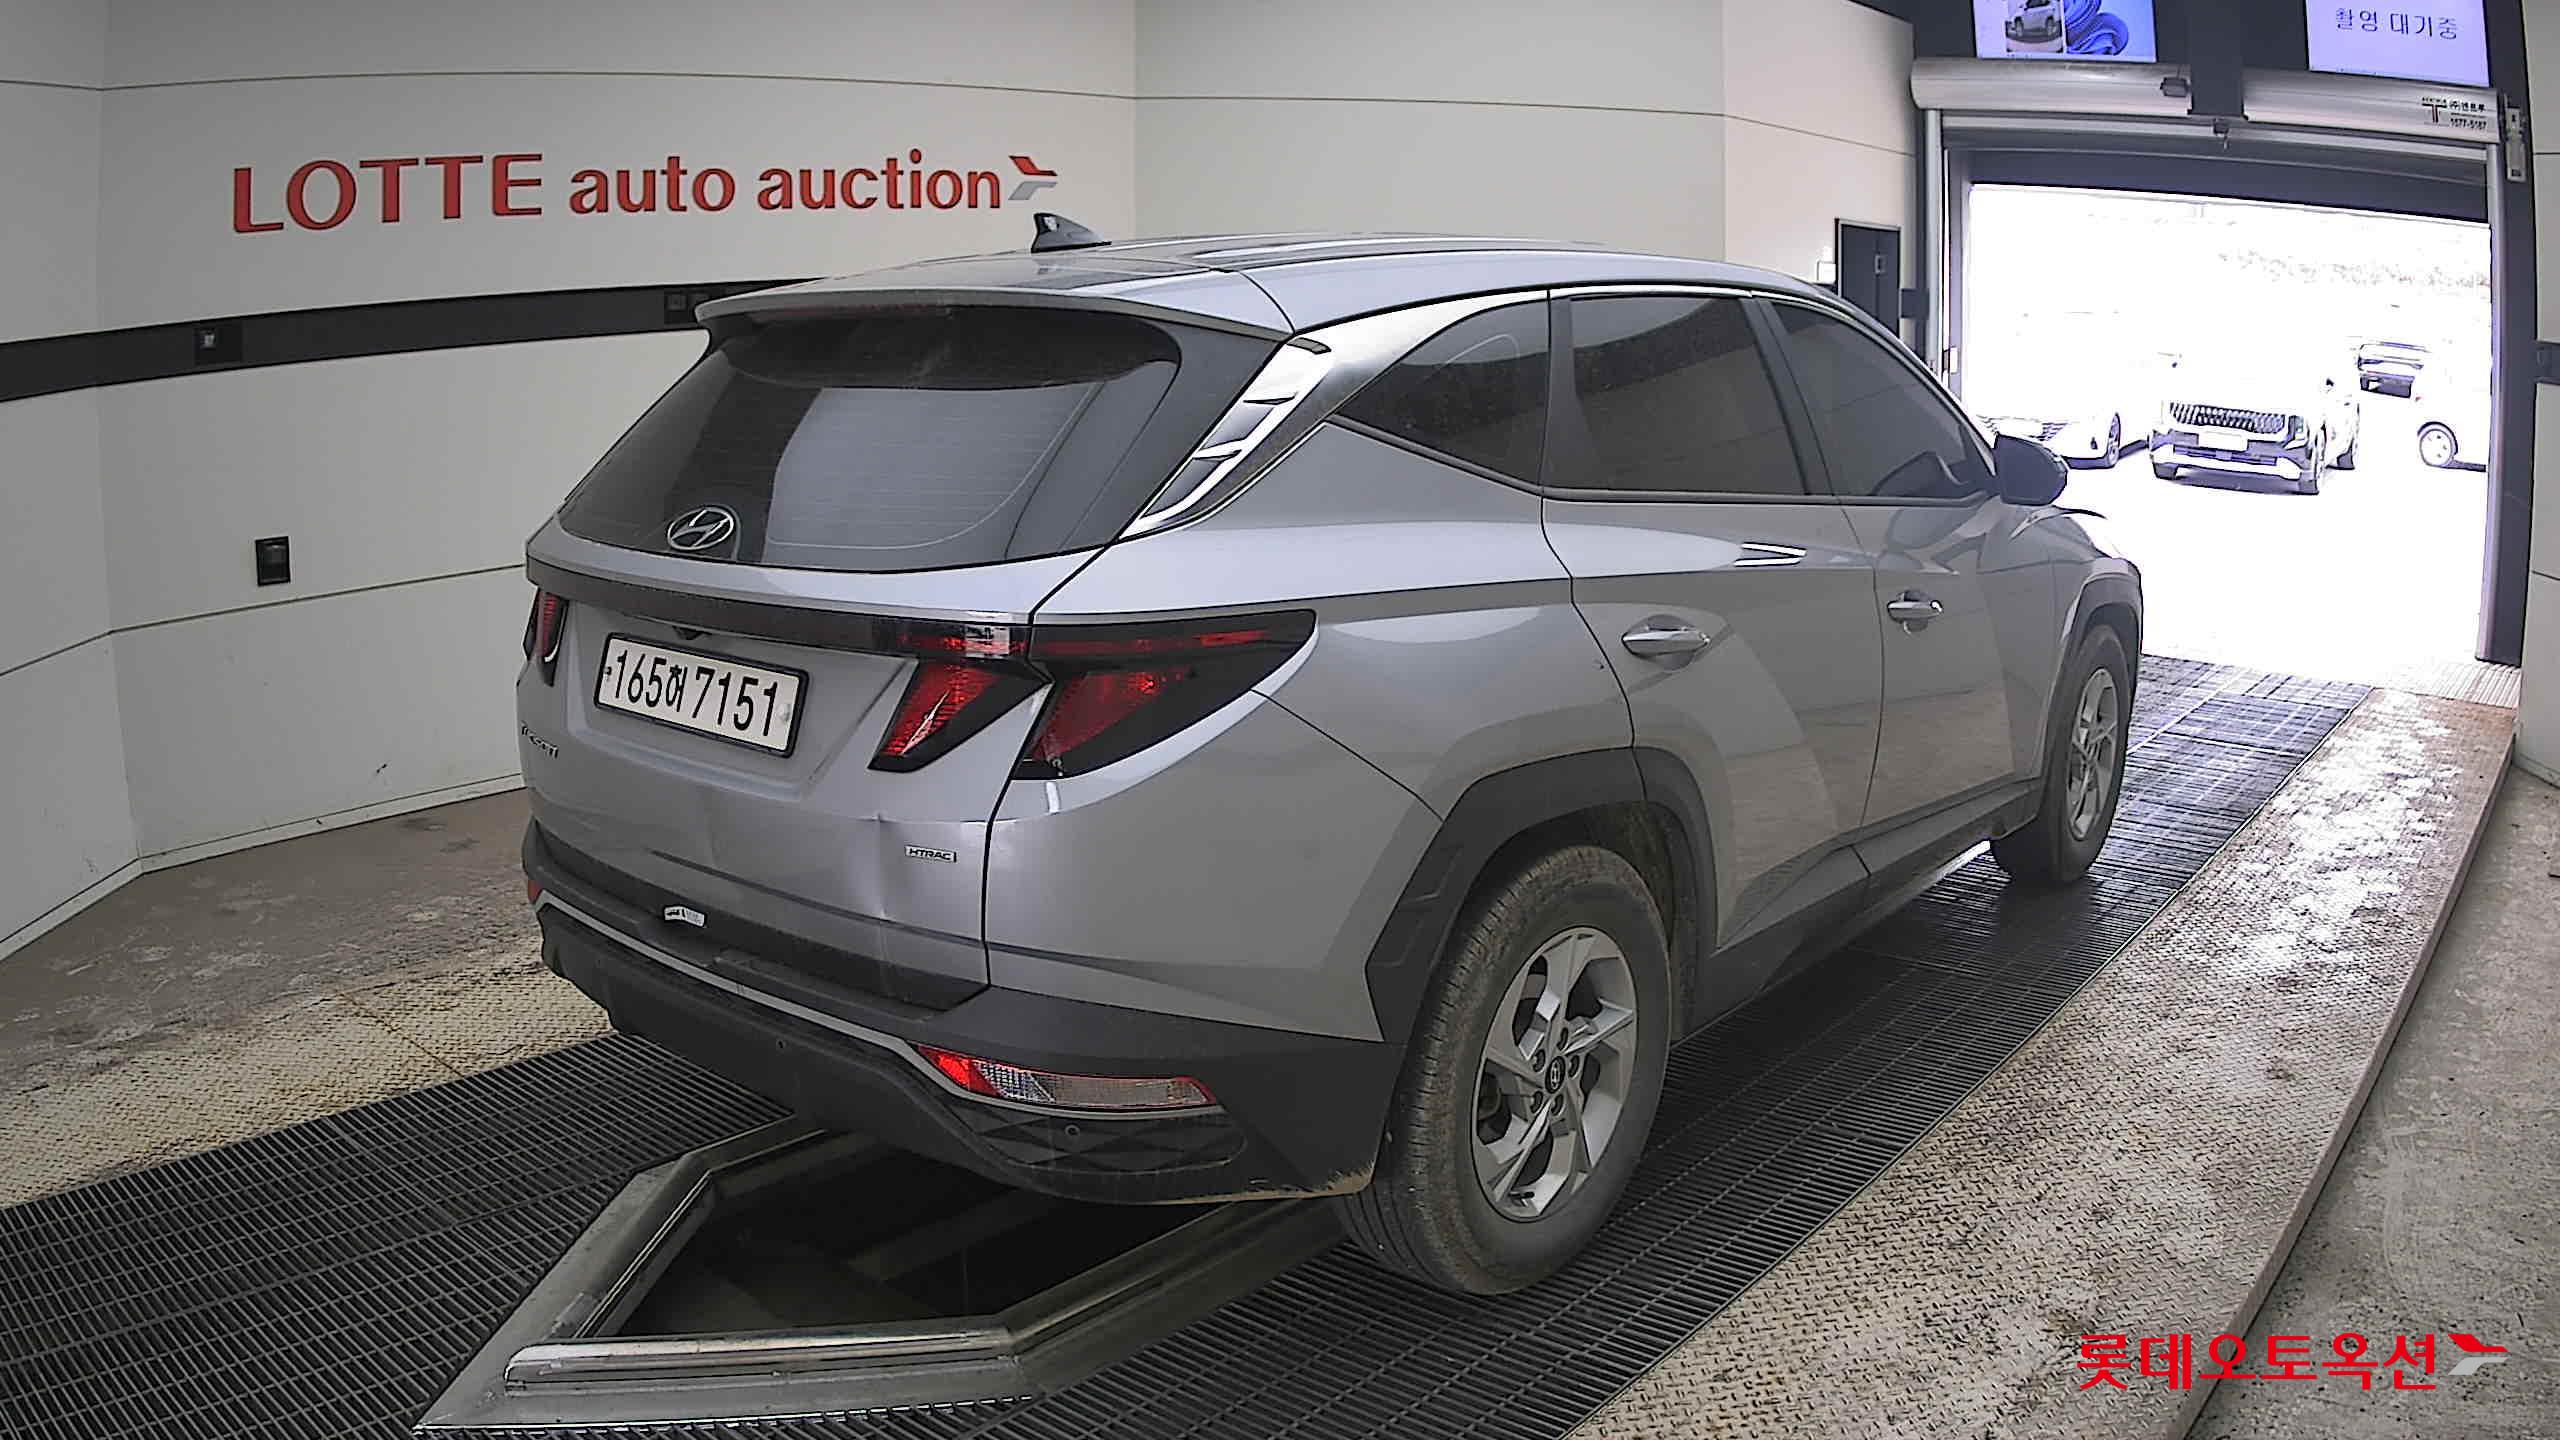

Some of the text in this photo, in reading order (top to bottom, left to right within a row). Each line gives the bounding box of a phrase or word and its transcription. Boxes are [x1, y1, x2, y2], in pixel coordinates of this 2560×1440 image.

[2336, 9, 2457, 40] 촬영 대기중
[233, 149, 1002, 233] LOTTE auto auction
[615, 650, 778, 737] 165허 7151
[909, 848, 951, 861] HTRAC
